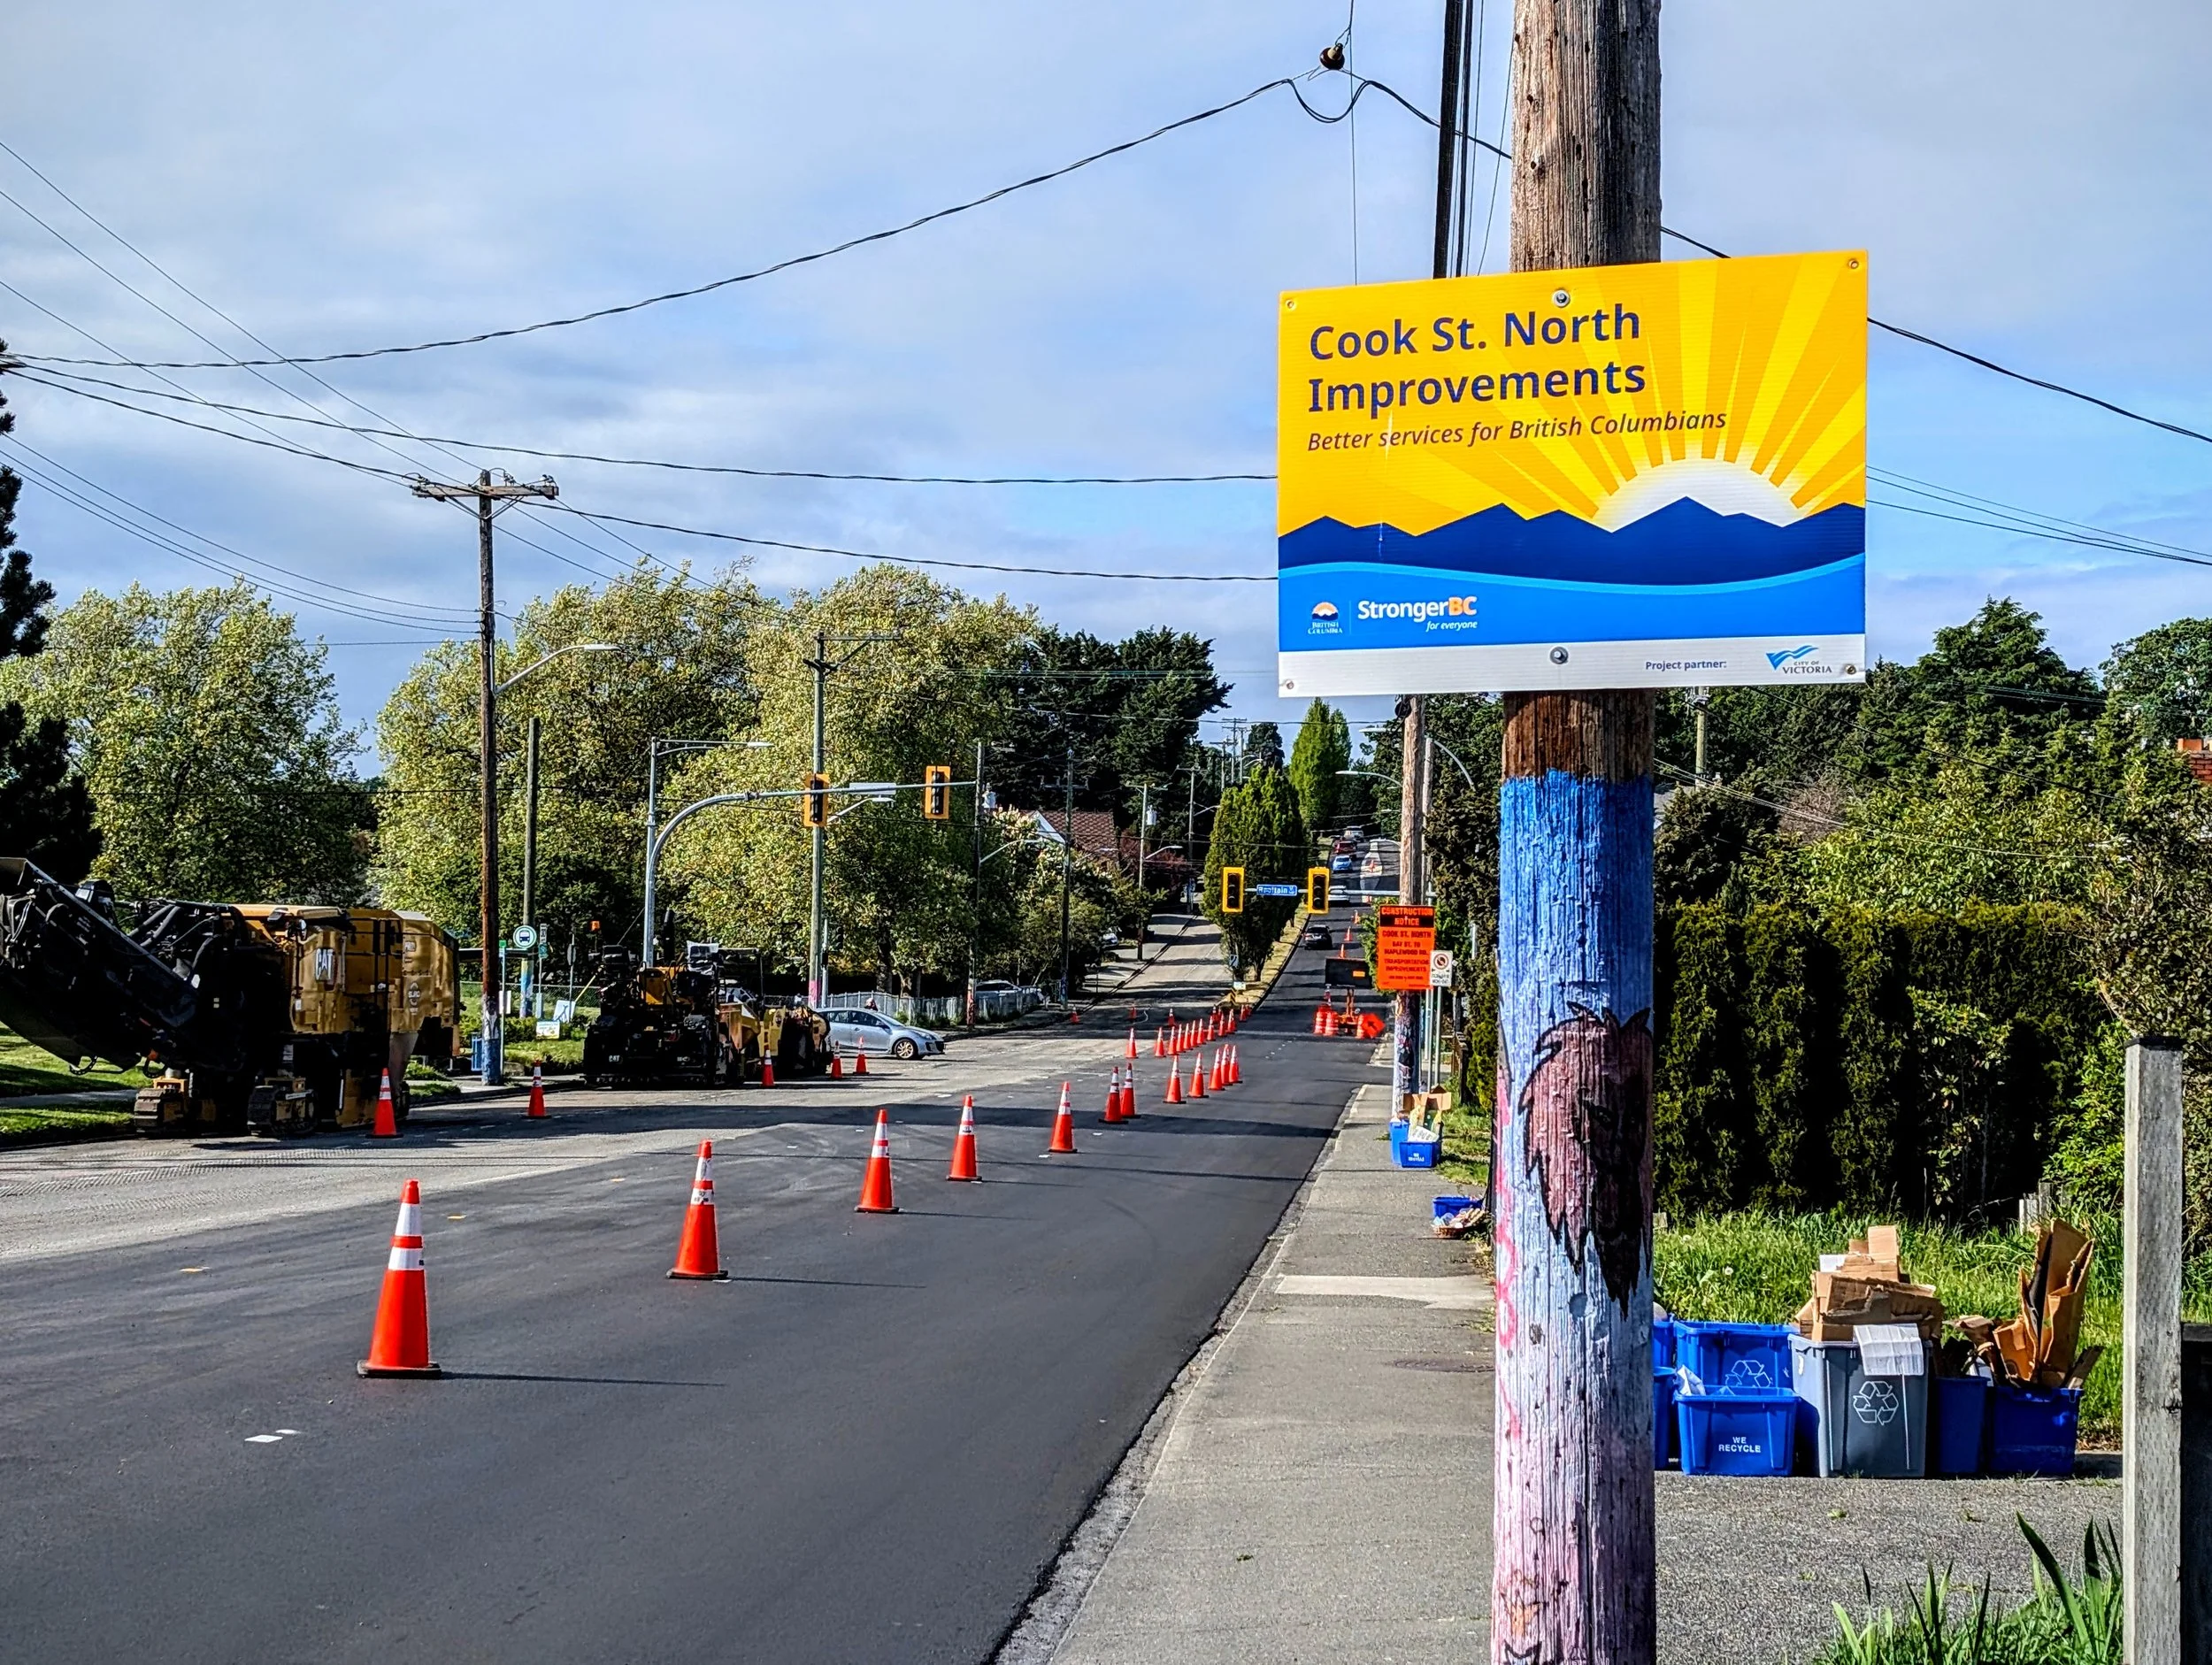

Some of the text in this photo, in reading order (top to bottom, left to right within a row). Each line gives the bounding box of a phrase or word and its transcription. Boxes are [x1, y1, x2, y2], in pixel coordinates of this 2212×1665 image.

[1310, 303, 1640, 360] Cook St. North
[1308, 359, 1646, 419] Improvements
[1308, 409, 1727, 452] Better services for British Columbians
[1357, 595, 1478, 623] StrongerBC
[1425, 620, 1478, 633] for everyone
[1645, 660, 1727, 672] Project partner:
[1782, 665, 1833, 674] VICTORIA
[1381, 907, 1433, 916] CONSTRUCTION
[315, 948, 334, 980] CAT
[1718, 1444, 1762, 1453] RECYCLE
